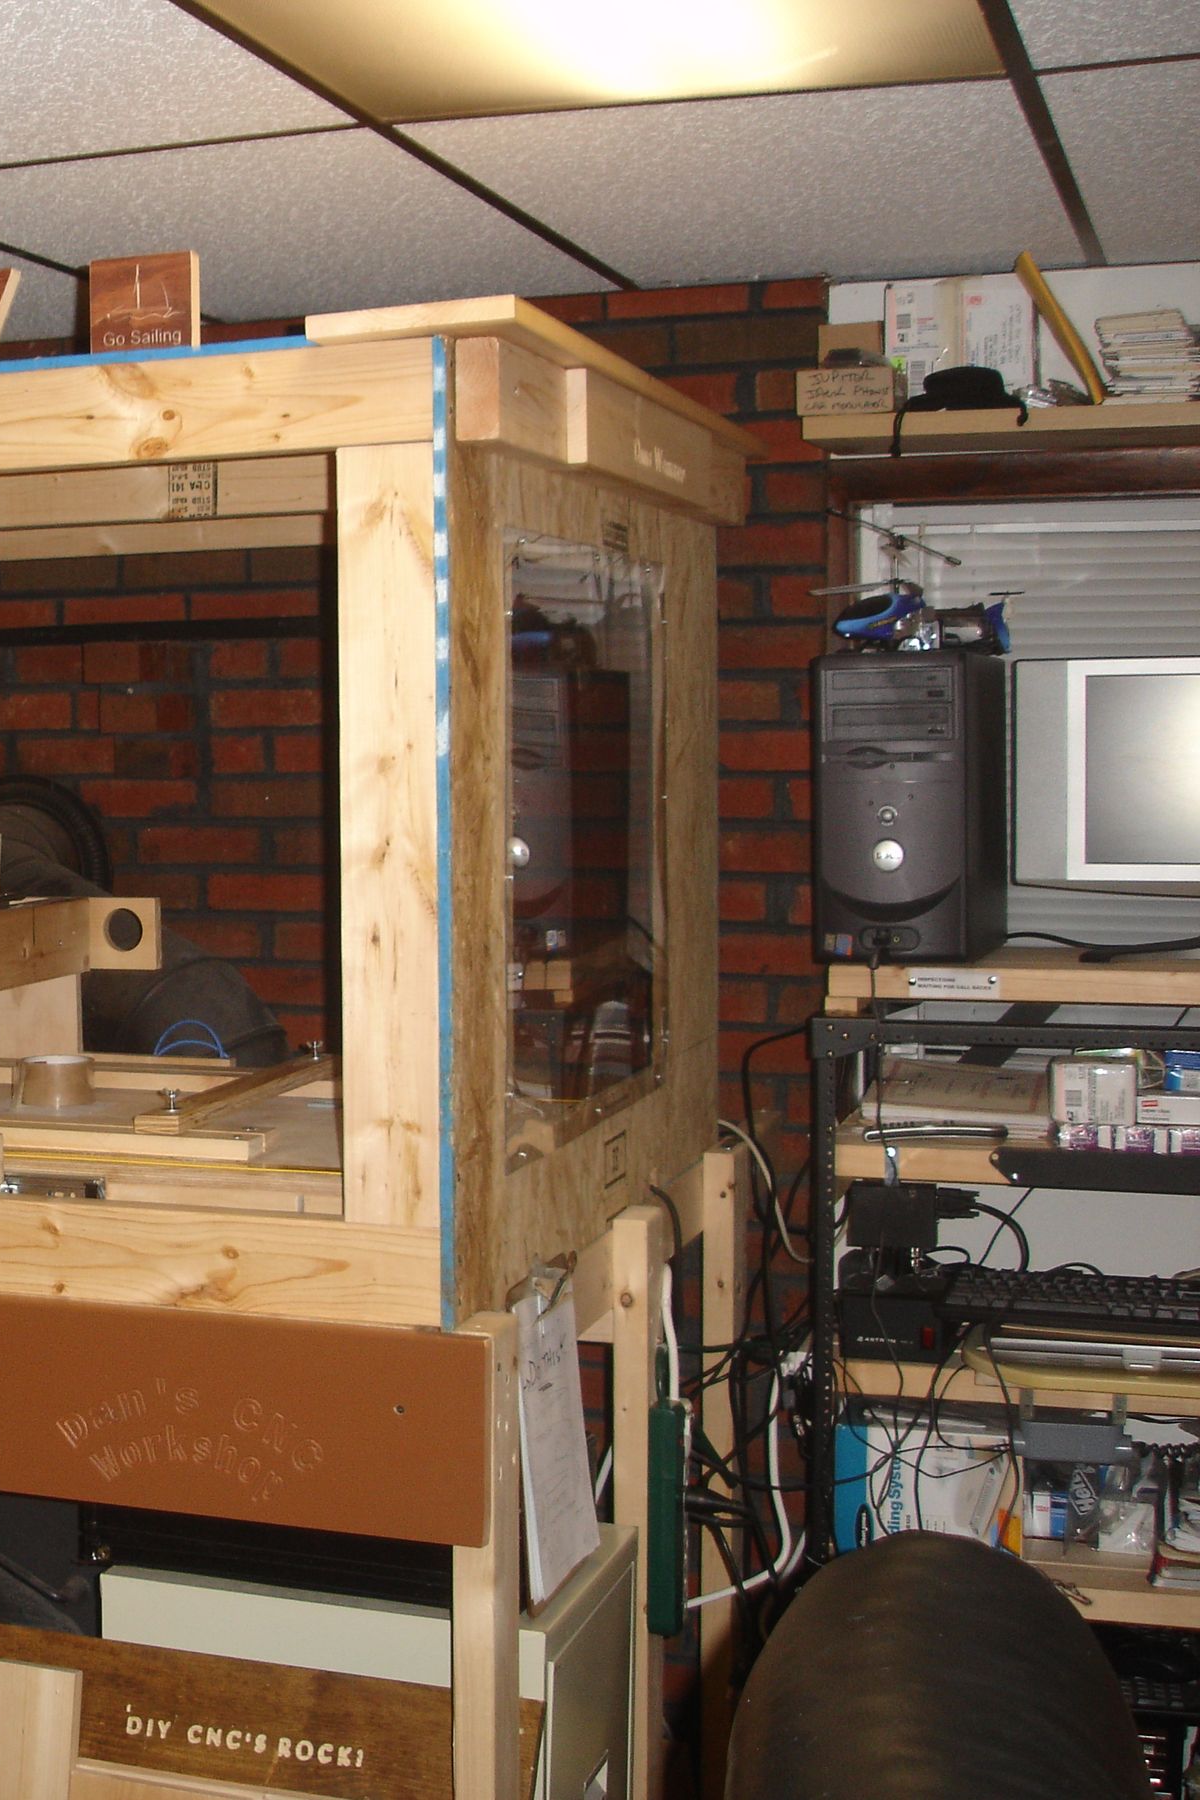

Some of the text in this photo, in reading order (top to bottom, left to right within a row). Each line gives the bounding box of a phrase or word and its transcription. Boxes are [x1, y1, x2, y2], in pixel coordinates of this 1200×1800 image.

[102, 326, 183, 348] Go Sailing
[55, 1377, 326, 1473] Dan's CNC
[88, 1423, 292, 1503] Workshop
[277, 1736, 365, 1768] ROCK!
